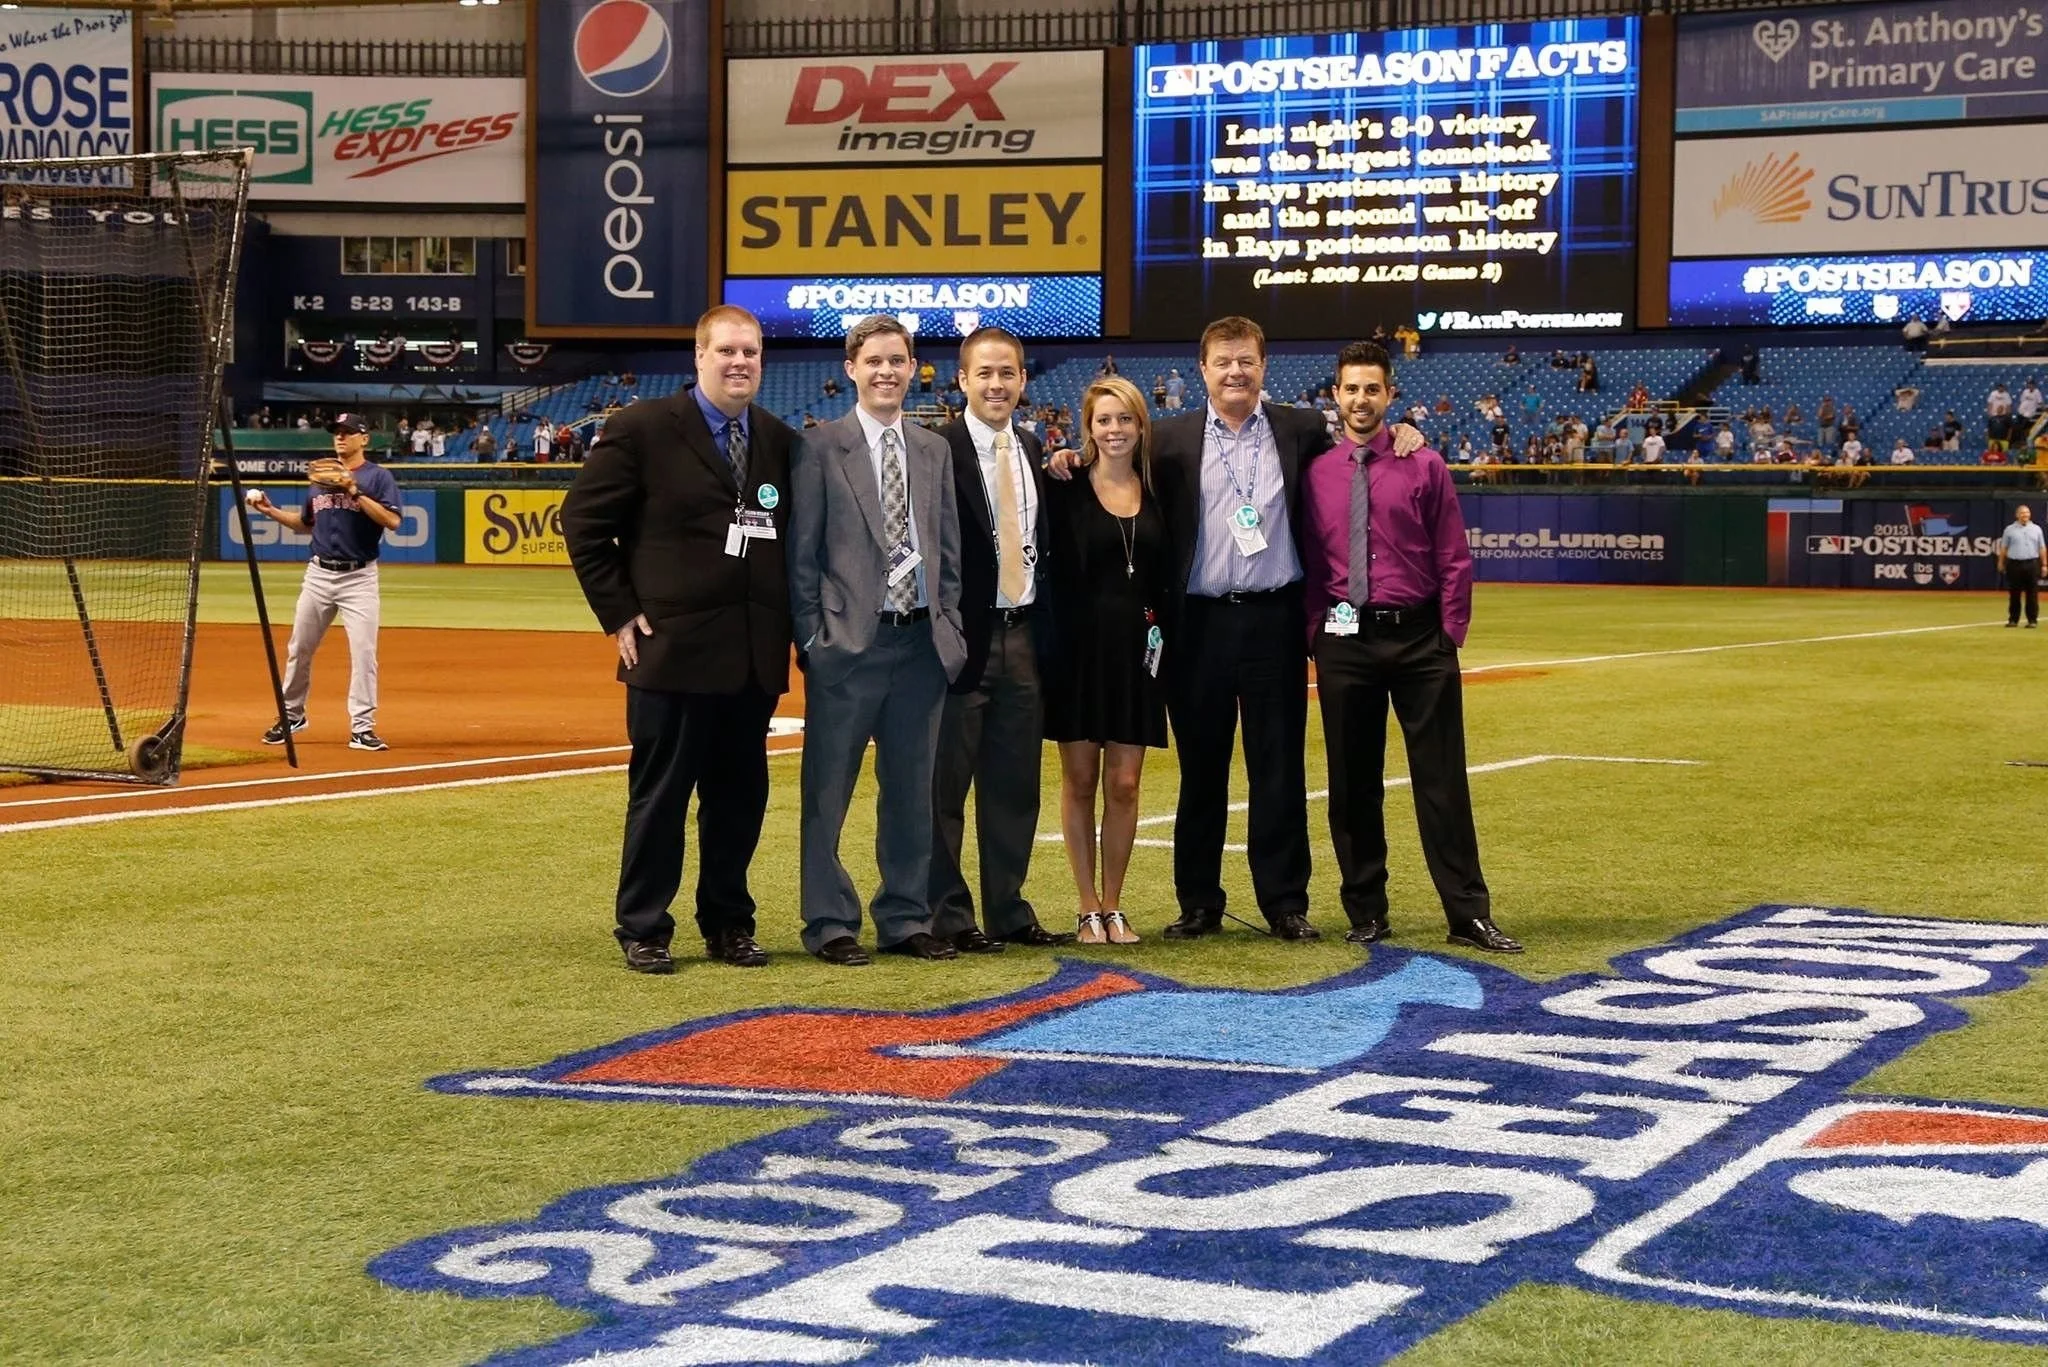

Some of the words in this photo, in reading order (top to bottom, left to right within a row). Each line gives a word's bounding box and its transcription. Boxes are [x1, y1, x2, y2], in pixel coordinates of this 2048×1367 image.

[9, 30, 48, 48] Where
[51, 22, 71, 39] the
[74, 18, 105, 34] Pros
[1810, 20, 1856, 49] St.
[1865, 8, 2043, 50] Anthony's
[1808, 59, 1945, 92] Primary
[1954, 52, 2036, 82] Care
[785, 62, 1019, 125] DEX
[318, 99, 433, 138] HESS
[1225, 124, 1285, 146] Last
[1290, 118, 1384, 146] night's
[1440, 113, 1537, 138] victory
[1760, 106, 1886, 123] SAPrimaryCare.org
[171, 119, 299, 154] HESS
[837, 126, 1035, 155] imaging
[1211, 156, 1261, 174] was
[1268, 151, 1311, 172] the
[1316, 146, 1411, 174] largest
[1417, 139, 1552, 166] comeback
[1203, 181, 1231, 202] in
[1236, 180, 1300, 206] Rays
[1306, 177, 1453, 205] postseason
[1459, 171, 1559, 196] history
[594, 114, 655, 298] pepsi
[741, 192, 1086, 249] STANLEY
[1222, 207, 1271, 230] and
[1277, 206, 1320, 228] the
[1326, 202, 1416, 227] second
[1423, 197, 1538, 223] walk-off
[1202, 237, 1230, 258] in
[1235, 236, 1300, 262] Rays
[1305, 234, 1452, 261] postseason
[1458, 228, 1558, 255] history
[1422, 263, 1478, 281] Game
[1743, 258, 2034, 293] #POSTSEASON
[294, 296, 325, 310] K-2
[351, 296, 394, 311] S-23
[406, 297, 462, 311] 143-B
[787, 284, 1030, 309] #POSTSEASON
[236, 460, 266, 472] OME
[268, 460, 286, 472] OF
[1465, 527, 1665, 550] icroLumen
[1874, 524, 1908, 536] 2013
[1557, 550, 1609, 560] MEDICAL
[1613, 550, 1664, 561] DEVICES
[1874, 564, 1908, 579] FOX
